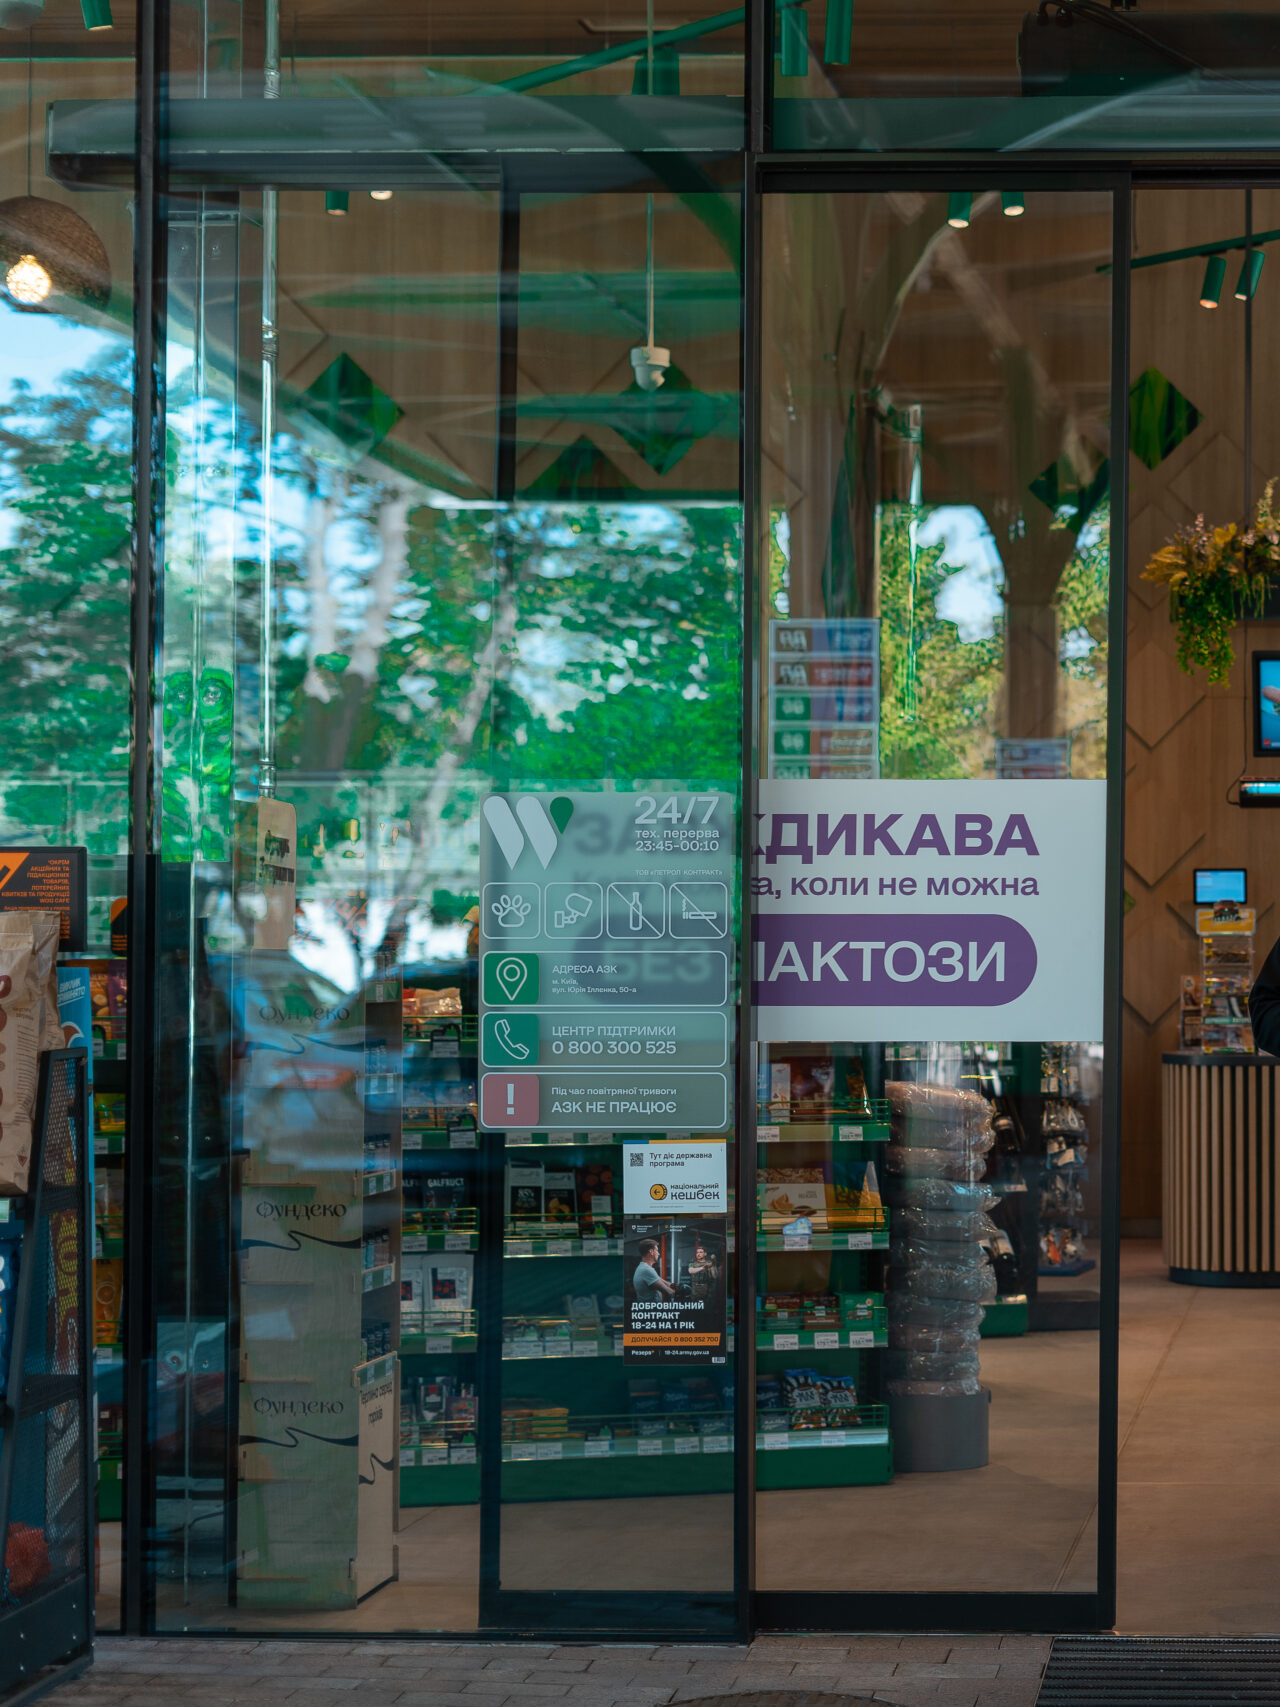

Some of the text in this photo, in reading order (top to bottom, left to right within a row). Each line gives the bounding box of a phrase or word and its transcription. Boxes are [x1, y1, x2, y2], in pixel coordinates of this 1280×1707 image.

[635, 796, 720, 824] 24/7
[635, 830, 720, 841] тех. перерва
[635, 840, 720, 852] 23:45-00:10
[791, 877, 868, 896] коли
[878, 878, 917, 896] не
[927, 878, 1040, 896] можна
[552, 965, 618, 974] АДРЕСА АЗК
[552, 1026, 676, 1038] ЦЕНТР ПІДТРИМКИ
[552, 1041, 676, 1055] 0 800 300 525
[552, 1087, 567, 1096] Під
[588, 1087, 637, 1096] повітряної
[552, 1102, 676, 1115] АЗК НЕ ПРАЦЮЄ
[664, 1152, 674, 1160] діє
[670, 1190, 720, 1200] кешбек
[256, 1201, 347, 1221] Фундеко
[631, 1301, 704, 1311] ДОБРОВІЛЬНИЙ
[631, 1312, 680, 1320] КОНТРАКТ
[254, 1397, 344, 1418] Фундеко
